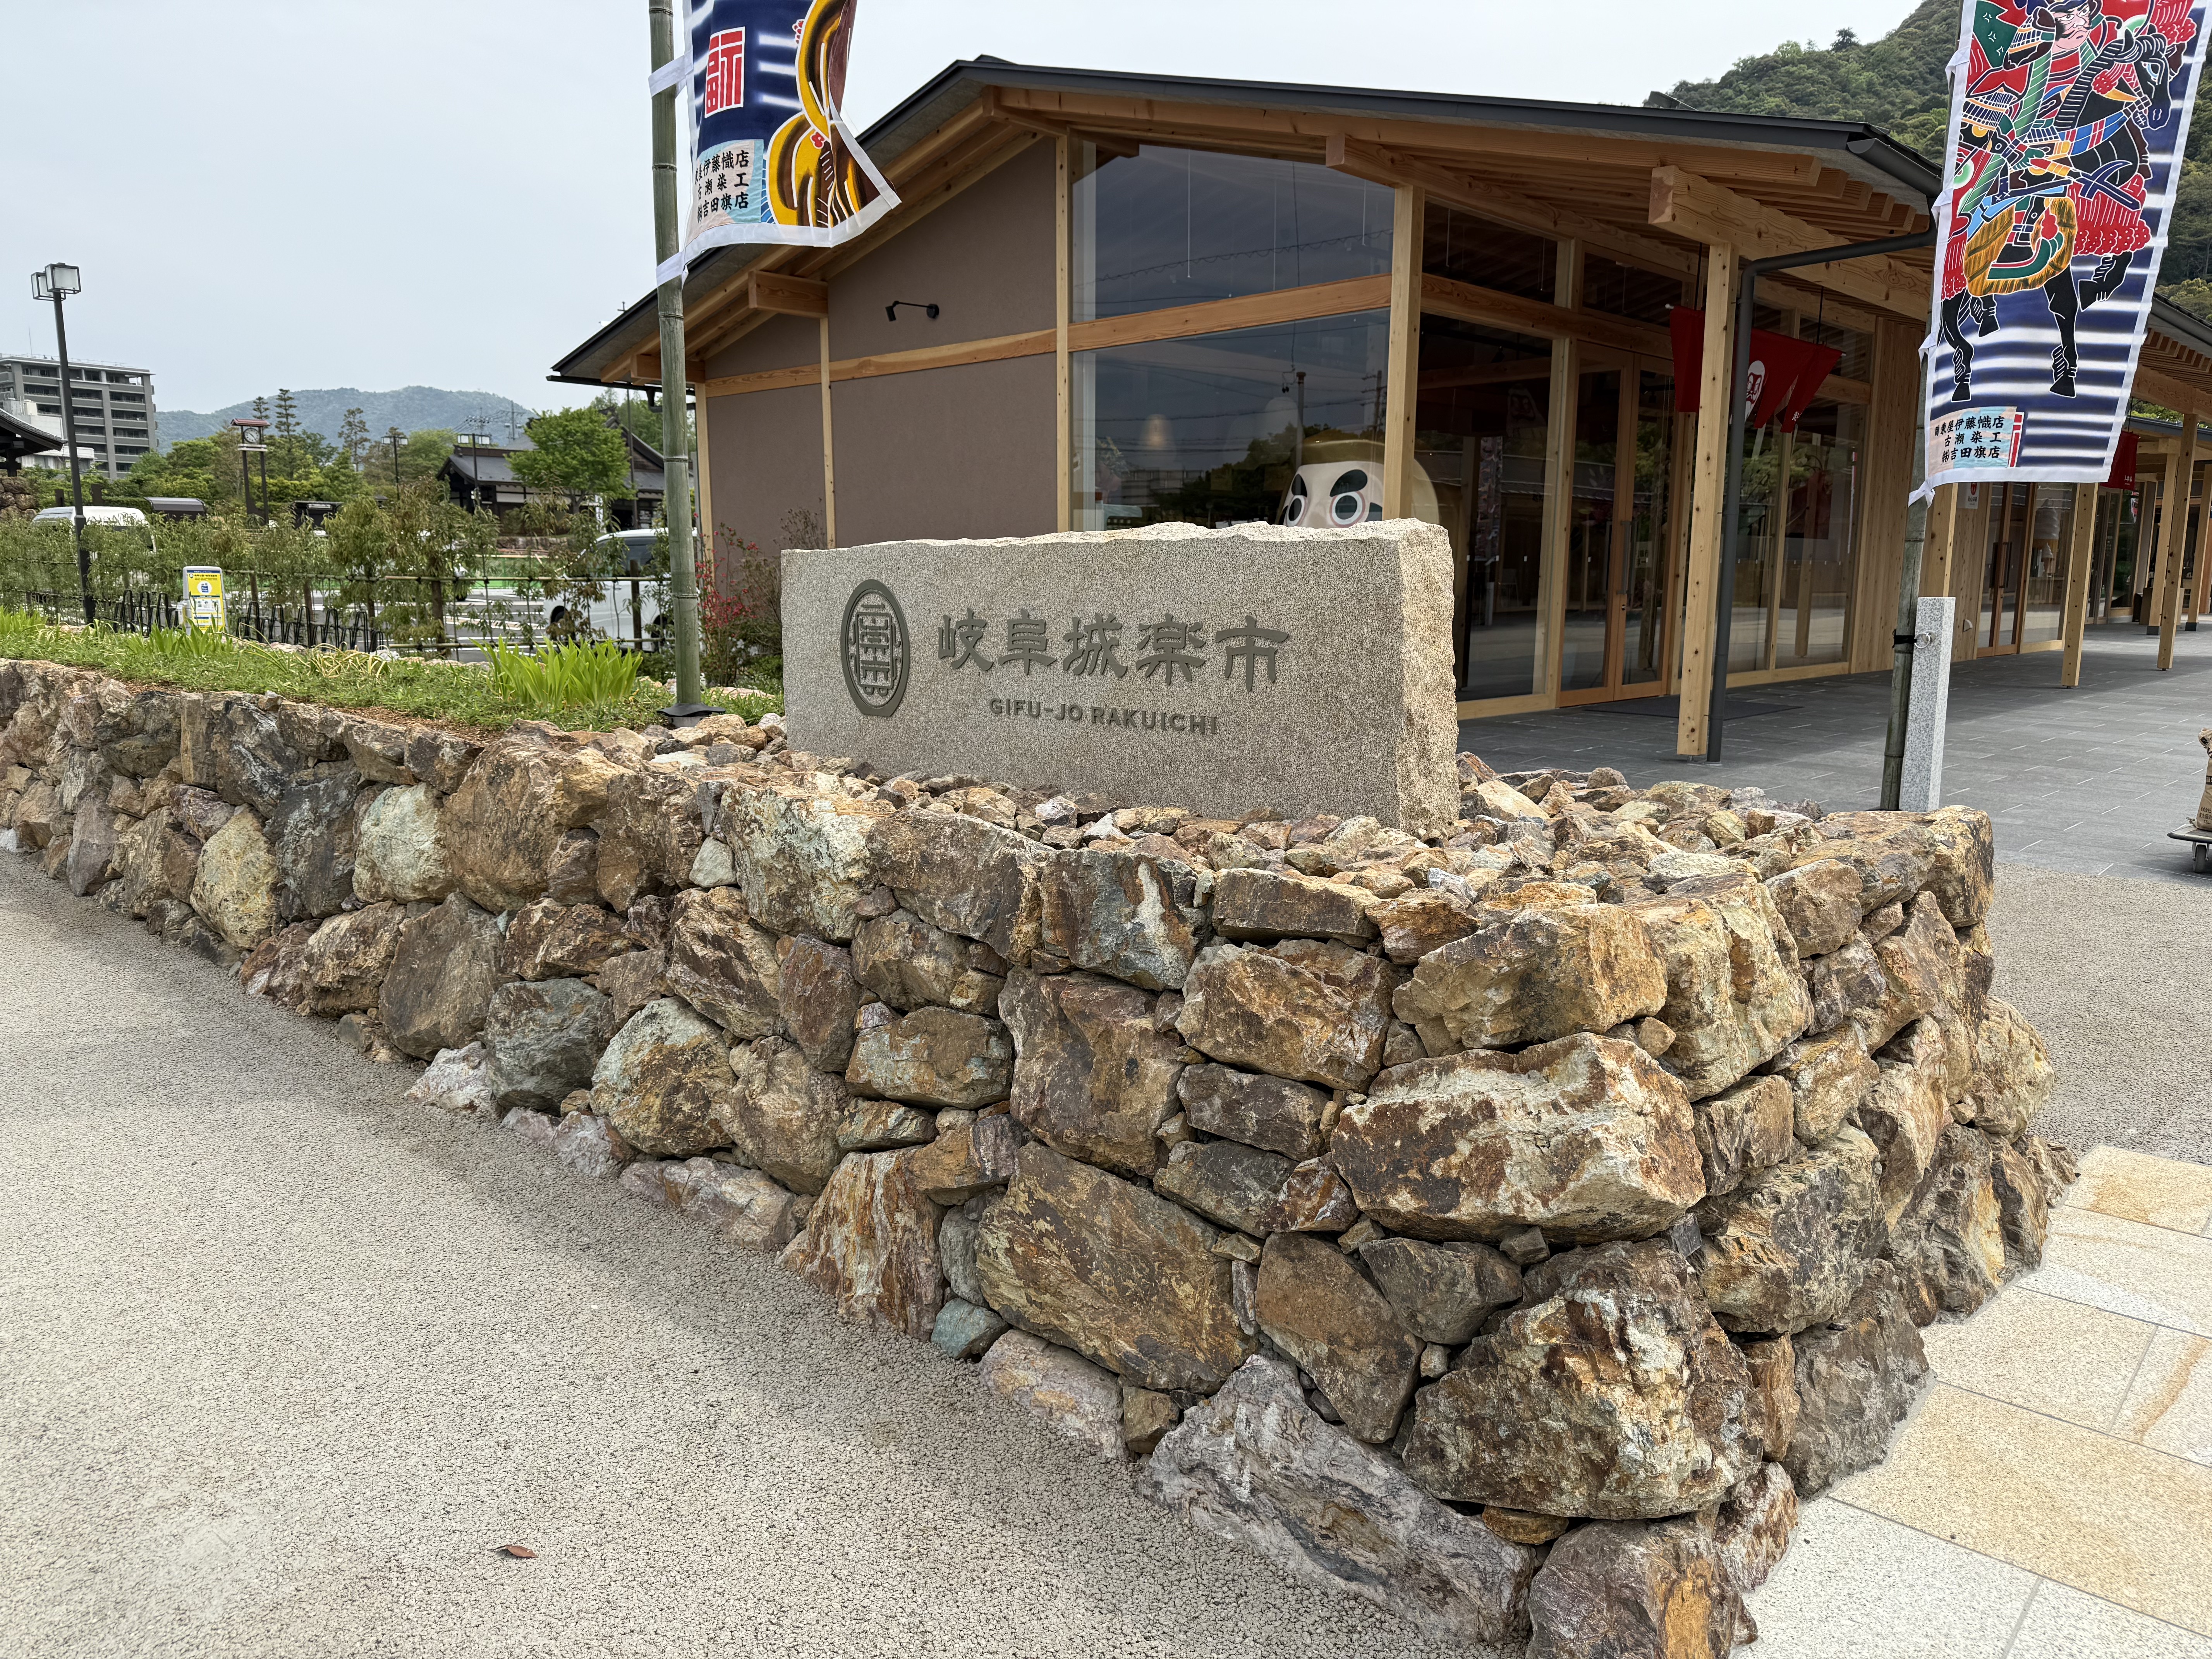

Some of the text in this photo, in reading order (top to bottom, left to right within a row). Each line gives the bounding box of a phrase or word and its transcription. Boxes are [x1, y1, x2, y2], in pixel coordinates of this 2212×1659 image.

[938, 607, 1290, 693] 岐阜城楽市
[989, 697, 1218, 734] GIFU-JO RAKUICHI
